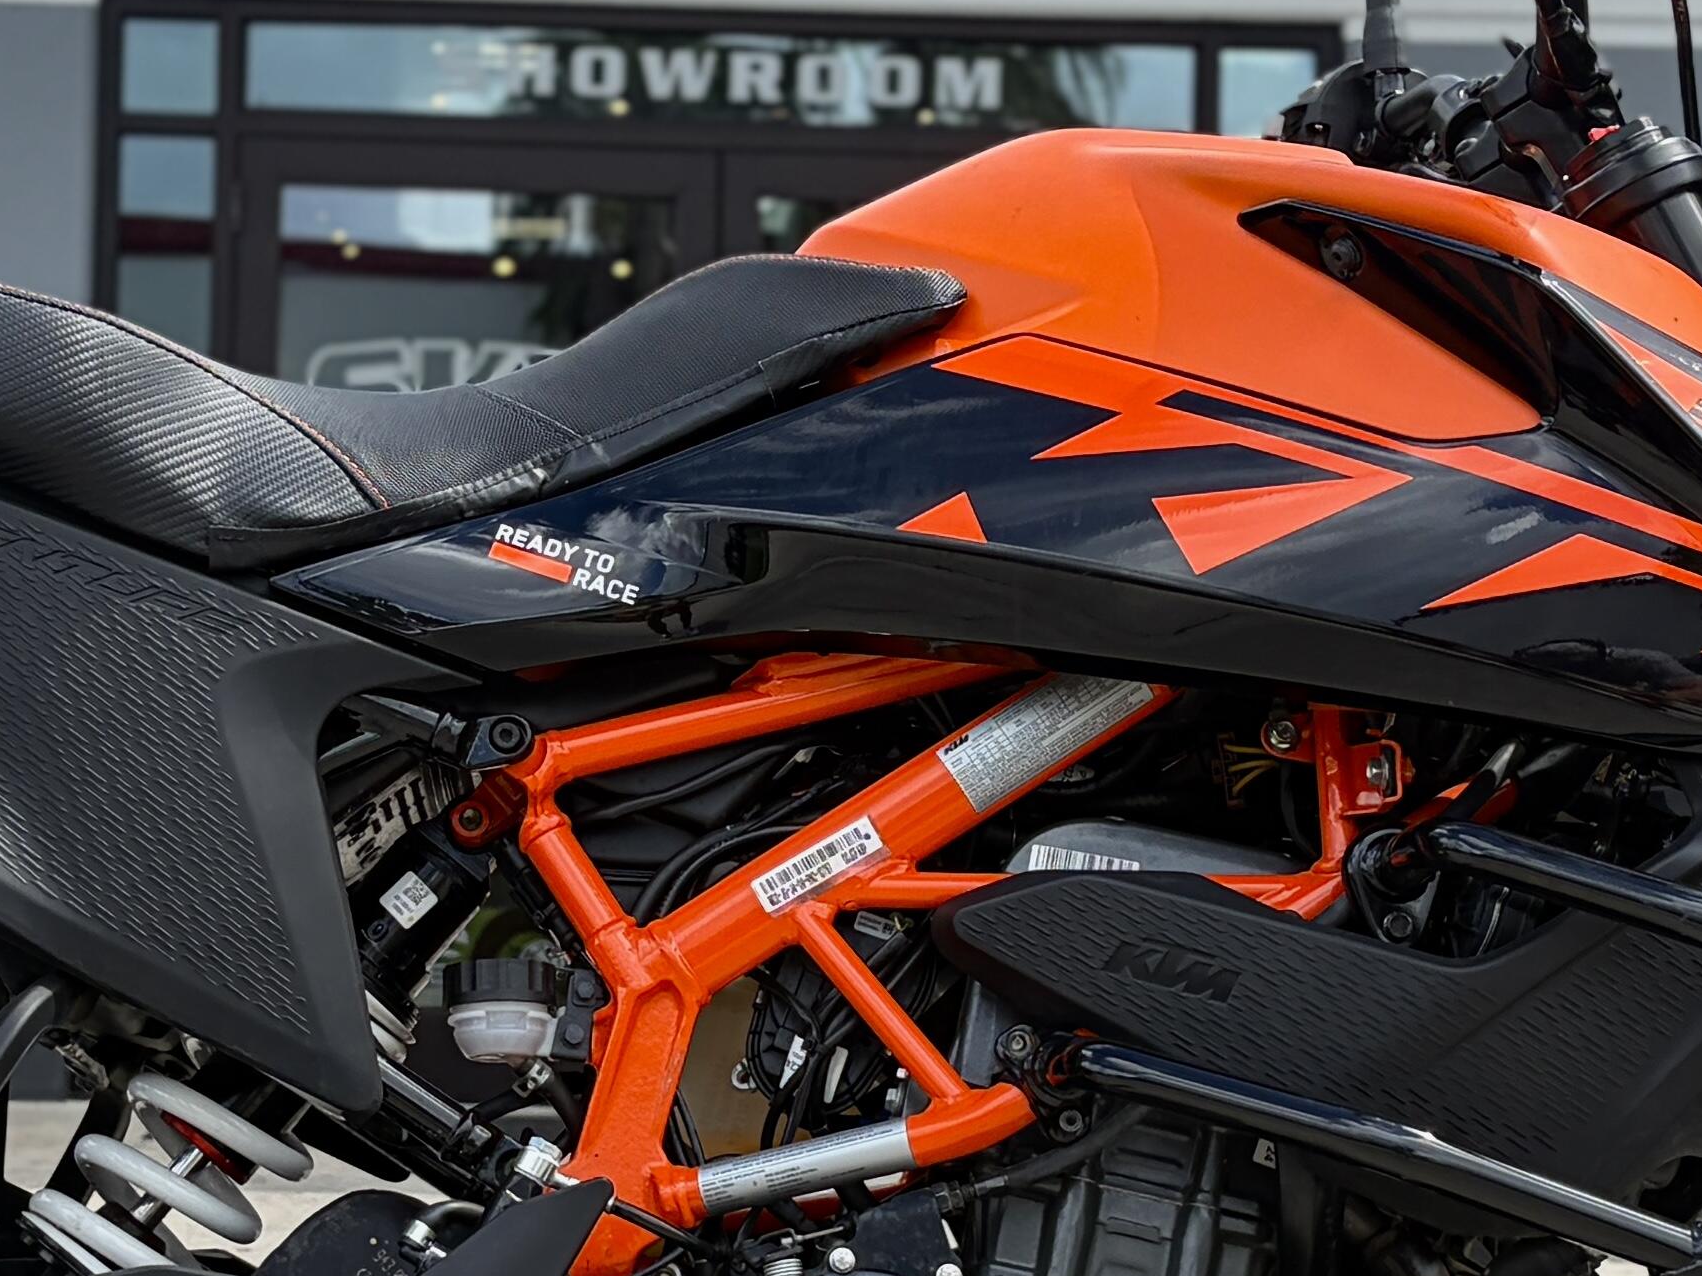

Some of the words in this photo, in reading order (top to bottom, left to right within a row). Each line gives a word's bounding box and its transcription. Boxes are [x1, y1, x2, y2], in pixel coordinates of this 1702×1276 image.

[495, 524, 579, 562] READY
[584, 548, 615, 573] TO
[572, 568, 640, 605] RACE
[1100, 937, 1242, 1003] KTM
